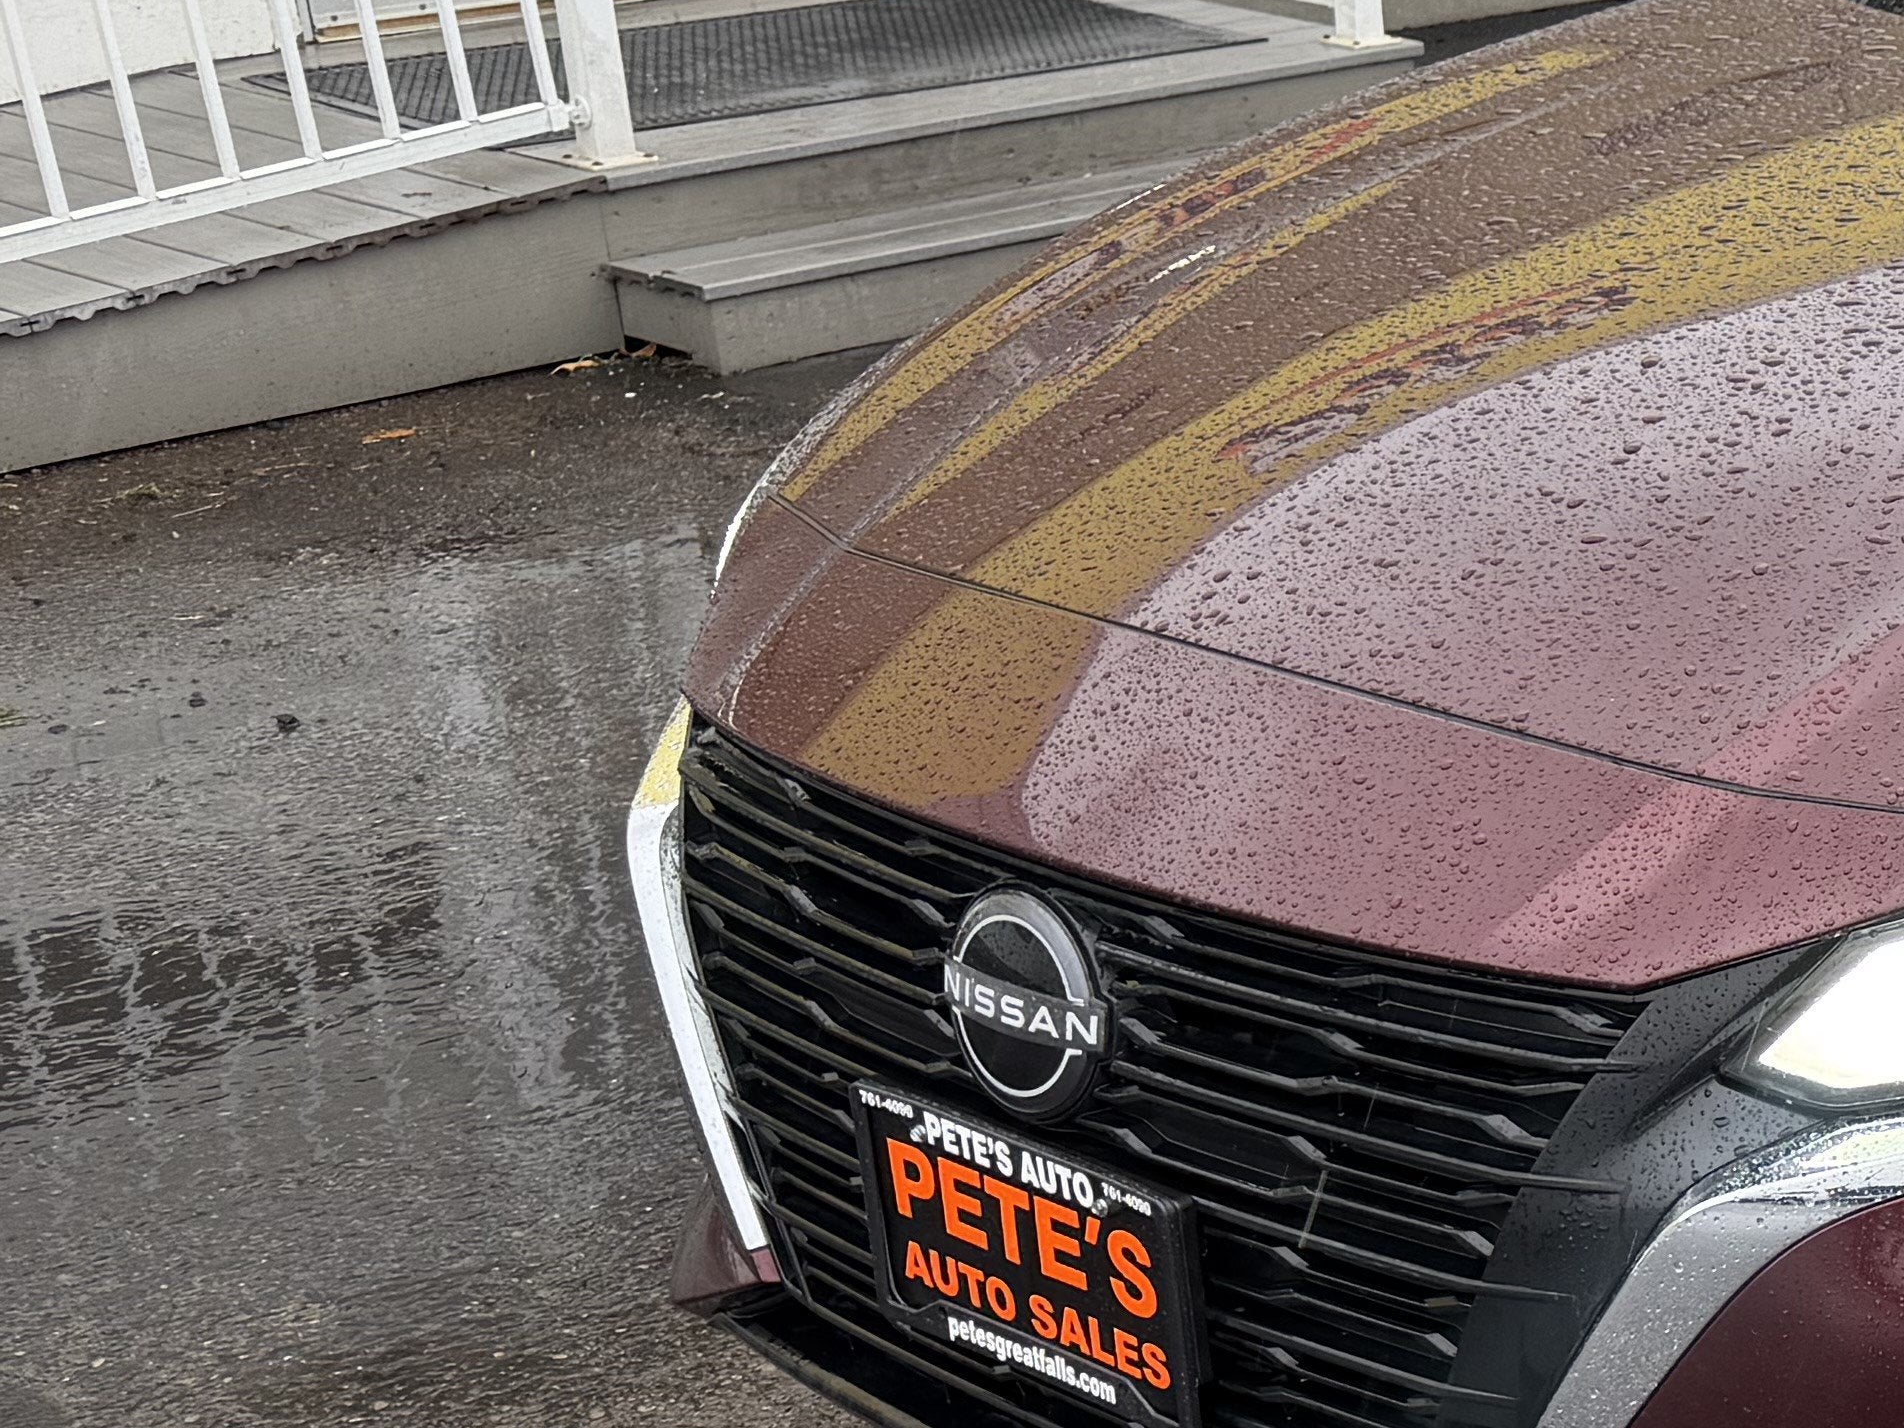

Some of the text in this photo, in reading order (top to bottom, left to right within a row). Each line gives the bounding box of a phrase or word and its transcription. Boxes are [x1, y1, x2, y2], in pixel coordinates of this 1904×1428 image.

[944, 962, 1098, 1046] NISSAN
[858, 1089, 914, 1119] 761-4090
[923, 1110, 1094, 1209] PETE'S AUTO
[886, 1136, 1159, 1320] PETE'S
[904, 1240, 1171, 1391] AUTO SALES
[947, 1314, 1117, 1405] petesgreatfalls.com
